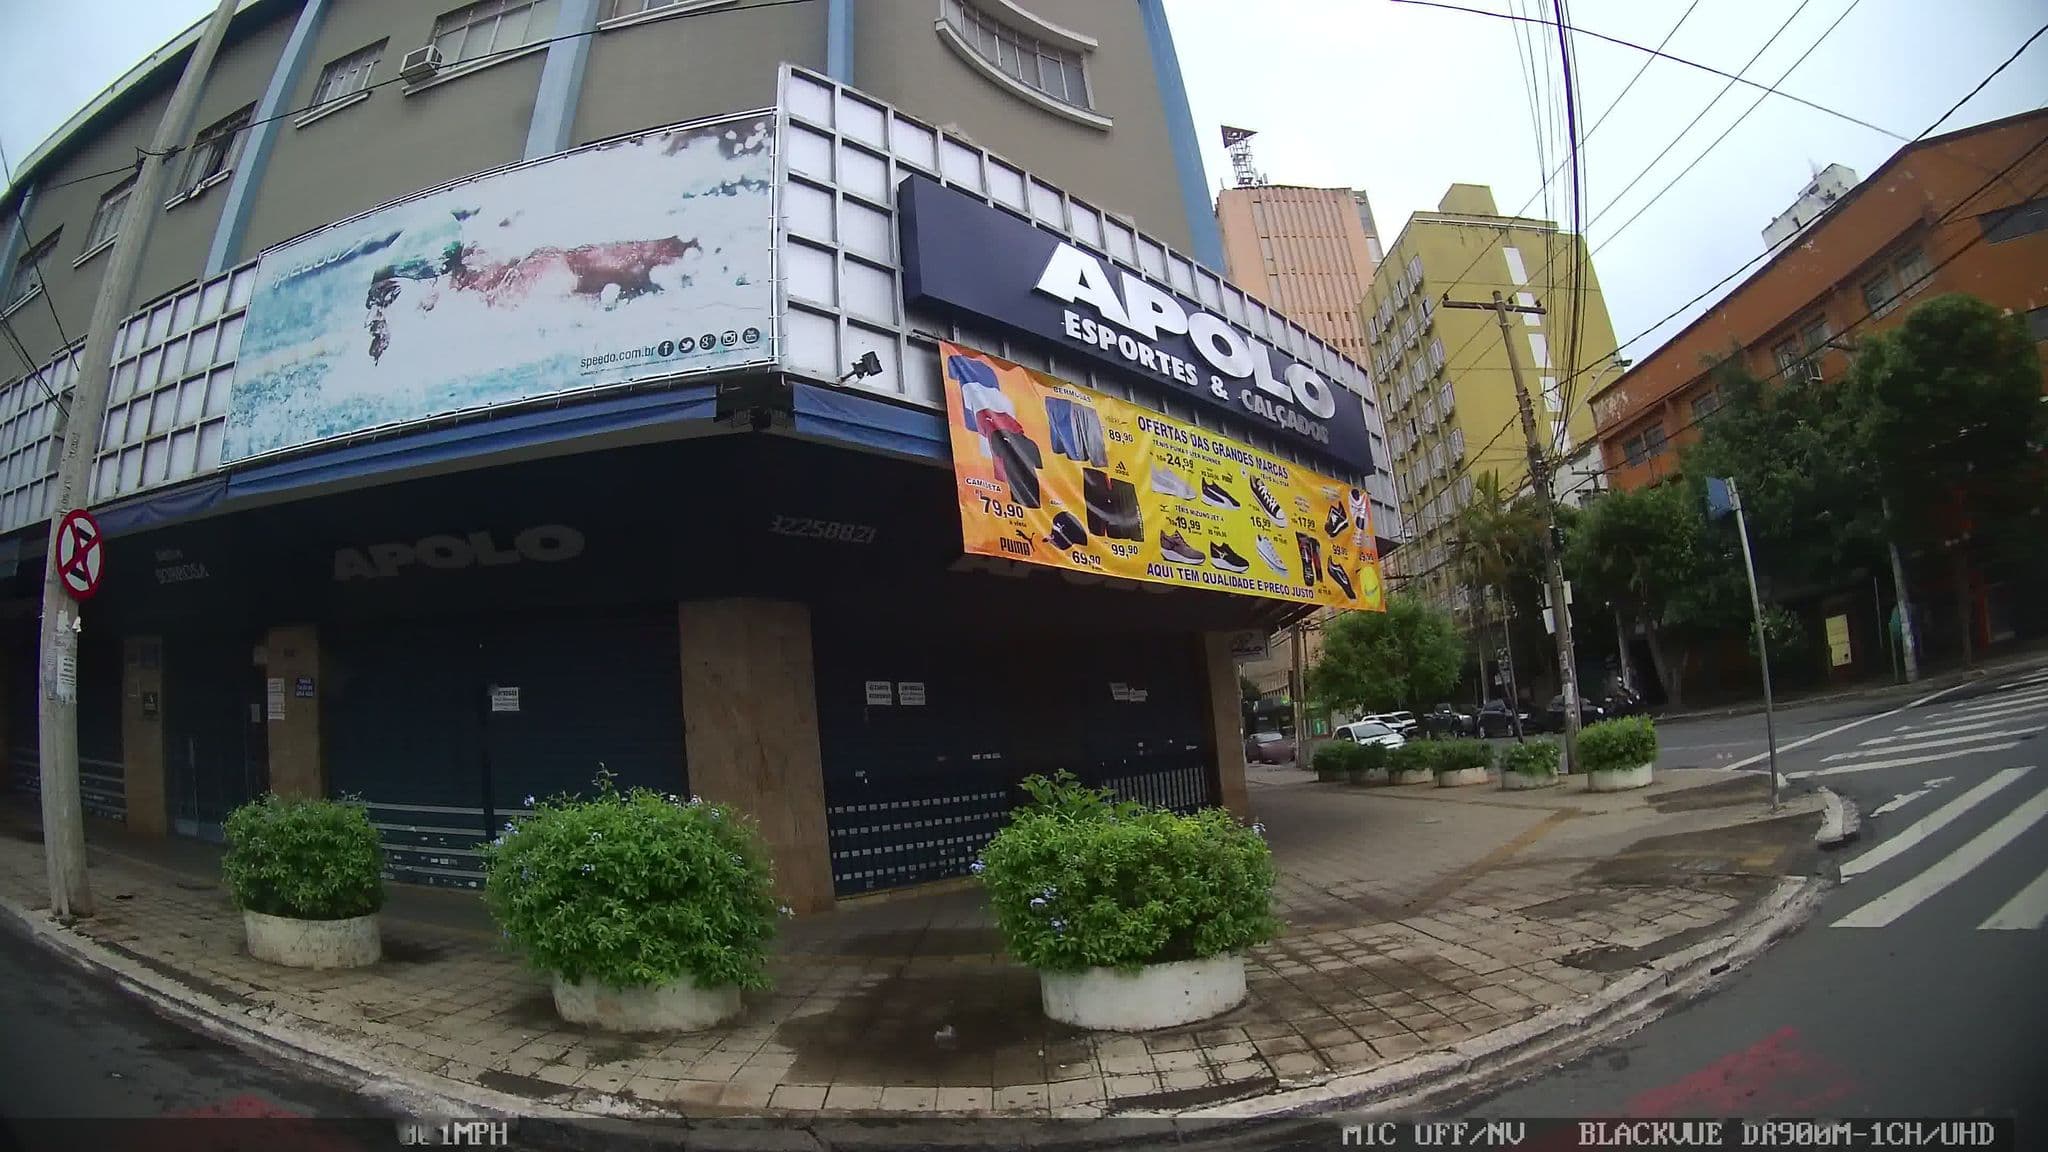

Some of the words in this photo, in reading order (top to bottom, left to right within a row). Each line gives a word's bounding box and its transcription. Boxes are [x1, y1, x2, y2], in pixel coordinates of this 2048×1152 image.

[1033, 241, 1336, 420] APOLO
[580, 344, 656, 369] speedo.com.br
[1063, 309, 1199, 386] ESPORTES
[1210, 375, 1230, 401] &
[1240, 388, 1330, 446] CALÇADOS
[1108, 429, 1134, 446] 89,90
[1137, 415, 1188, 445] OFERTAS
[1190, 432, 1210, 452] DAS
[1211, 441, 1254, 468] GRANDES
[1255, 457, 1289, 480] MARCAS
[1166, 453, 1194, 471] 24,99
[965, 477, 1002, 492] CAMISETA
[980, 495, 1024, 519] 79,90
[1176, 515, 1201, 533] 19,99
[334, 524, 585, 580] APOLO
[1000, 537, 1031, 556] PUMA
[1111, 543, 1139, 559] 99,90
[1072, 550, 1101, 566] 69,90
[1146, 563, 1173, 579] AQUI
[1177, 568, 1200, 582] TEM
[1202, 572, 1255, 590] QUALIDADE
[1257, 579, 1263, 590] E
[1291, 585, 1314, 599] JUSTO
